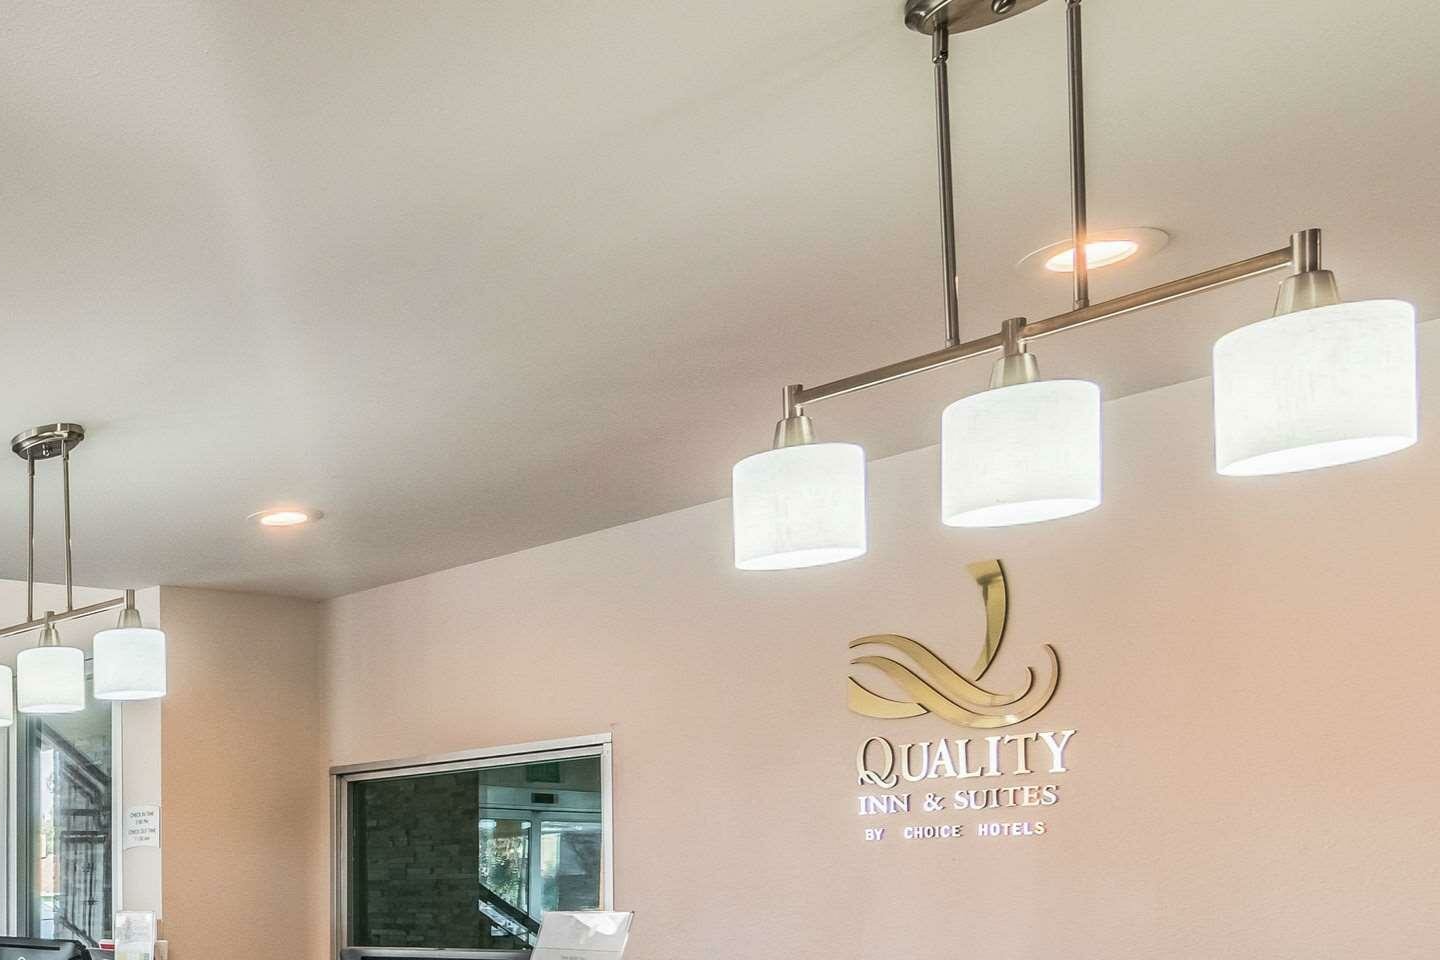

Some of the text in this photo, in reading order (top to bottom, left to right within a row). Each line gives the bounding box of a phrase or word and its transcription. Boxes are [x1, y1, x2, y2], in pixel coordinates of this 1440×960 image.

[857, 728, 1078, 789] QUALITY
[857, 784, 1059, 816] INN & SUITES
[865, 821, 1046, 842] BY CHOICE HOTELS
